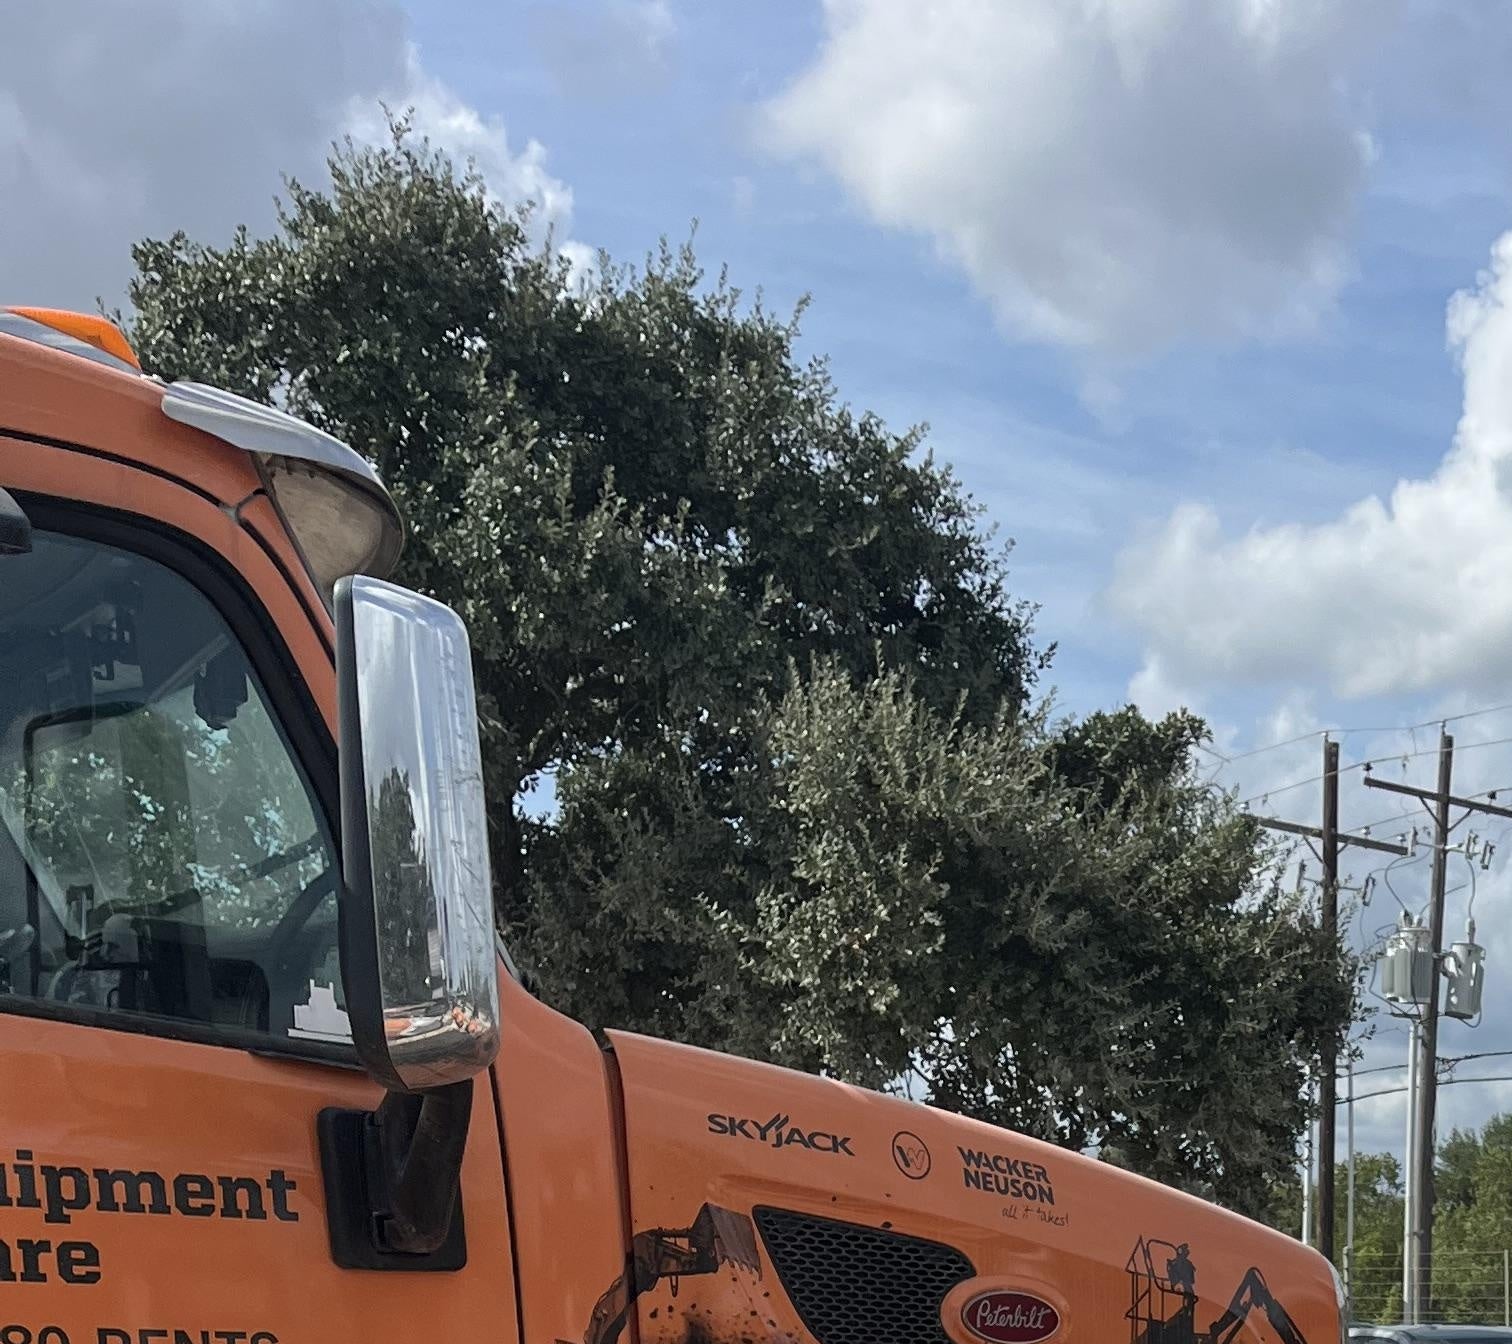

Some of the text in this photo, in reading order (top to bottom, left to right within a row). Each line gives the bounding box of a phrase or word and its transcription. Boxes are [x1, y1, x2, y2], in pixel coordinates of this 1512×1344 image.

[707, 1113, 855, 1157] SKYJACK
[957, 1146, 1053, 1184] WACKER
[963, 1167, 1056, 1206] NEUSON
[976, 1299, 1050, 1331] Peterbilt
